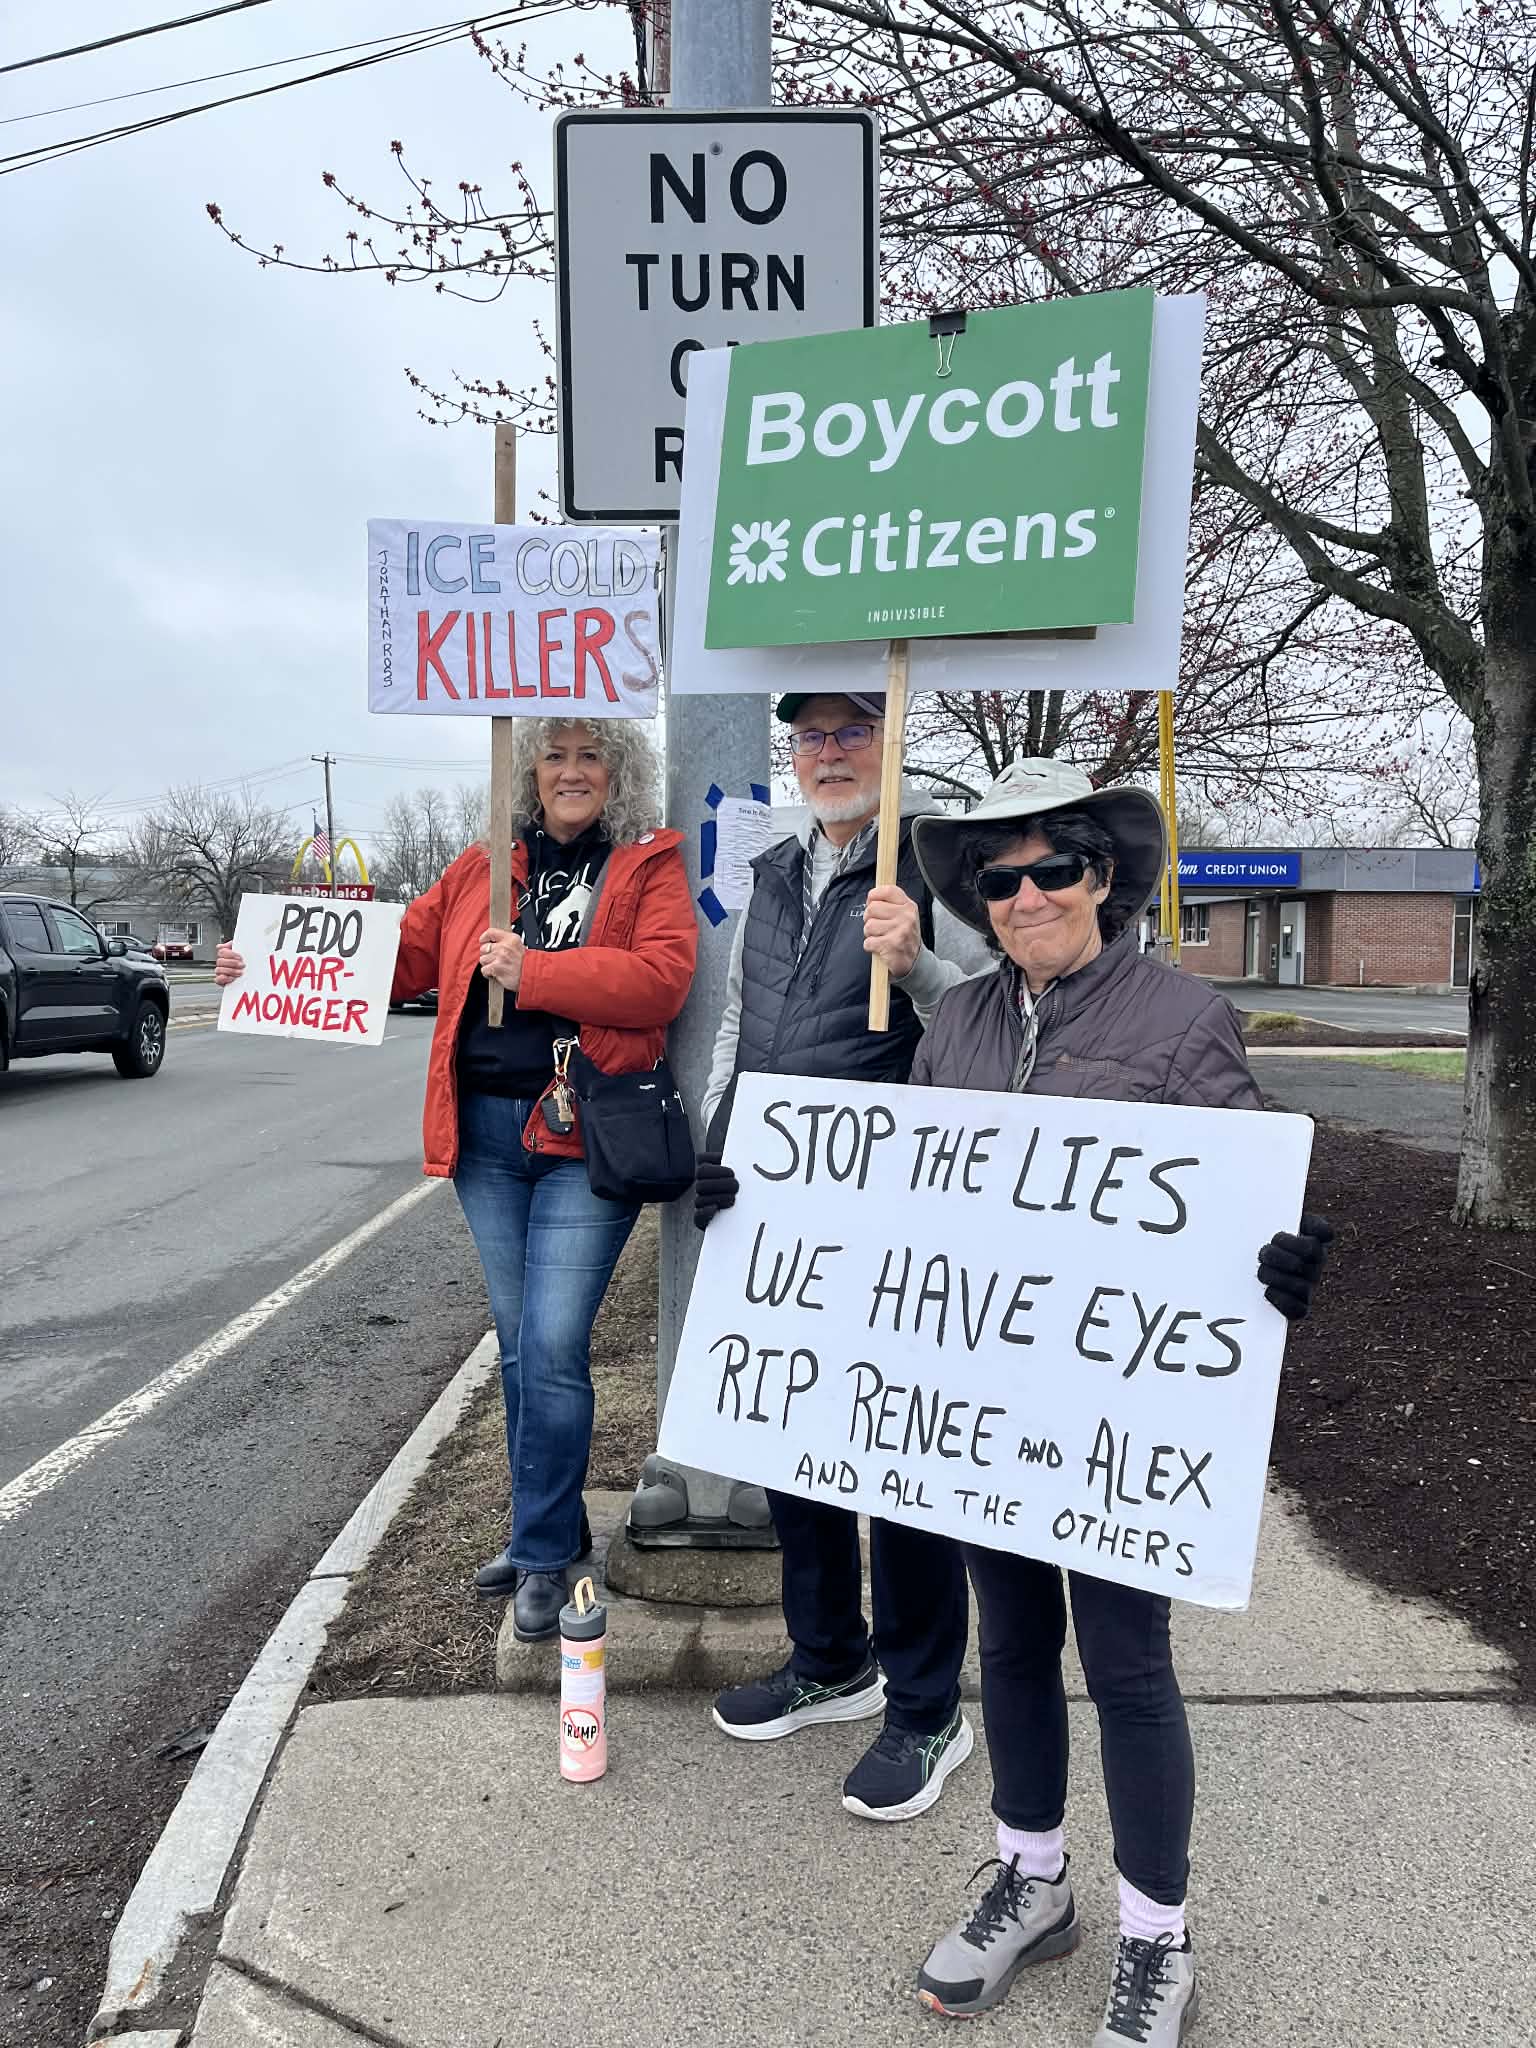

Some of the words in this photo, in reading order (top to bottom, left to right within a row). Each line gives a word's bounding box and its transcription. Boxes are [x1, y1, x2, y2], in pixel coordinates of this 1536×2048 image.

[650, 149, 787, 225] NO
[625, 253, 805, 312] TURN
[745, 352, 1121, 473] Boycott
[406, 531, 501, 596] ICE
[516, 537, 648, 597] COLD
[868, 606, 945, 623] INDIVISIBLE
[417, 607, 658, 702] KILLERS
[1205, 864, 1247, 875] CREDIT
[1249, 864, 1288, 875] UNION
[275, 903, 363, 958] PEDO
[269, 954, 354, 992] WAR-
[232, 990, 369, 1034] MONGER
[753, 1101, 896, 1190] STOP
[910, 1125, 1000, 1193] THE
[1012, 1126, 1200, 1235] LIES
[745, 1222, 843, 1310] WE
[868, 1246, 1054, 1352] HAVE
[1075, 1286, 1247, 1379] EYES
[708, 1333, 819, 1431] RIP
[845, 1361, 1007, 1469] RENEE
[1017, 1436, 1063, 1469] AND
[1086, 1417, 1212, 1513] ALEX
[794, 1452, 859, 1494] AND
[880, 1469, 933, 1509] ALL
[954, 1489, 1022, 1526] THE
[1052, 1507, 1195, 1576] OTHERS
[562, 1720, 597, 1739] TRUMP
